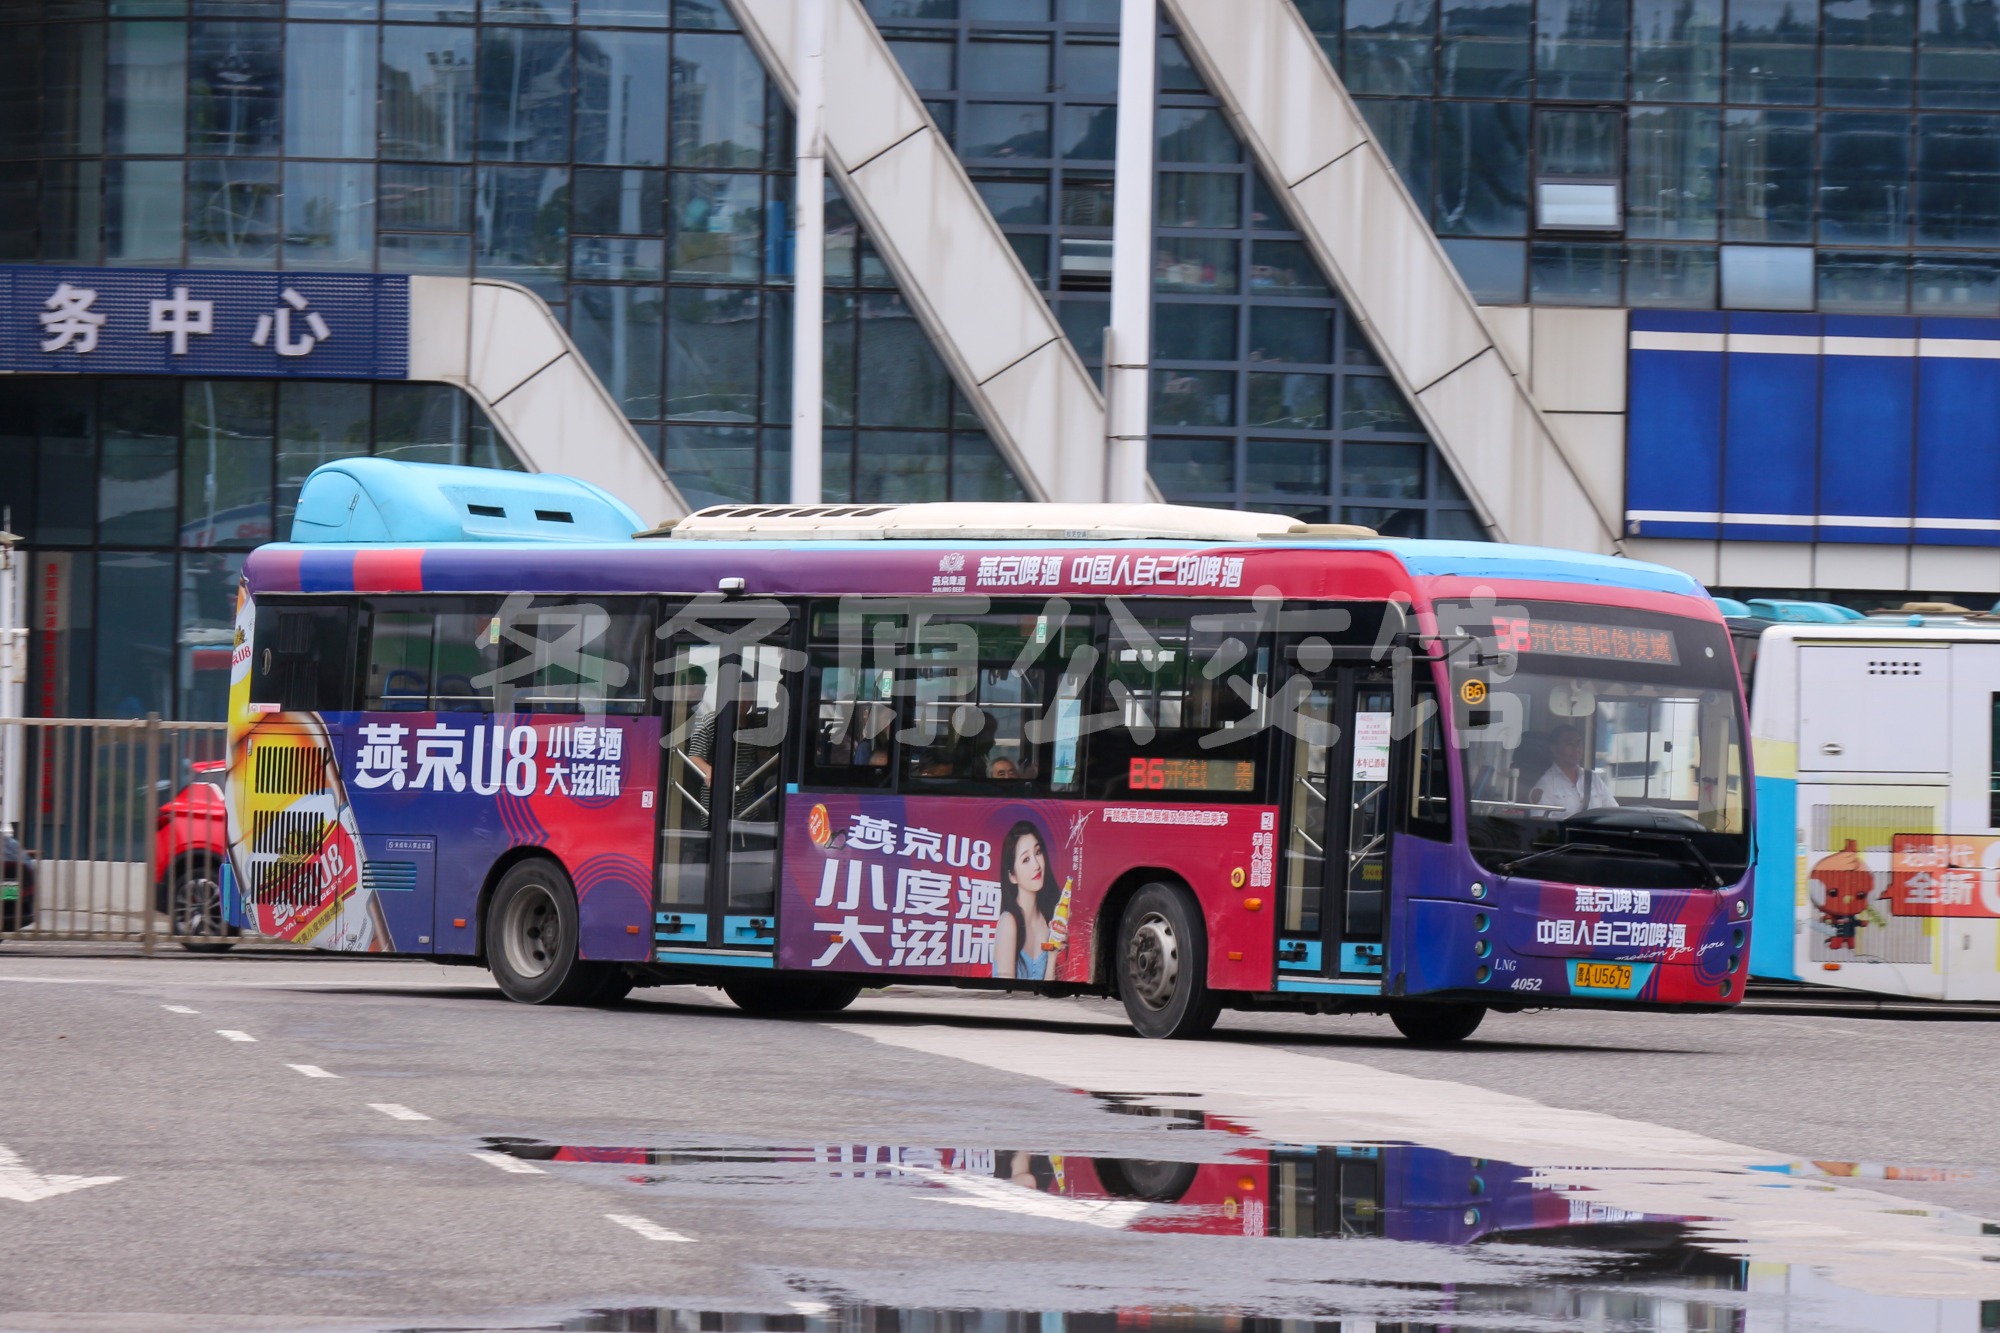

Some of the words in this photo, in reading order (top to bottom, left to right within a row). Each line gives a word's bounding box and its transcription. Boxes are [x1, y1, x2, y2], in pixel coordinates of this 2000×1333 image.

[40, 283, 331, 356] 务中心
[932, 576, 967, 586] 燕京啤酒
[976, 556, 1064, 586] 燕京啤酒
[1070, 555, 1245, 588] 中国人自己的啤酒
[1466, 685, 1481, 699] B6
[354, 723, 538, 796] 燕京U8
[546, 726, 623, 760] 小度酒
[545, 763, 620, 797] 大滋味
[1103, 808, 1228, 826] 严禁携带易燃易爆及危险物品乘车
[846, 814, 992, 871] 燕京U8
[1250, 832, 1263, 887] 无人售票
[1261, 832, 1273, 887] 自觉投币
[815, 858, 1001, 921] 小度酒
[1575, 888, 1650, 914] 燕京啤酒
[1904, 871, 1975, 905] 全新
[811, 915, 998, 967] 大滋味
[1537, 920, 1686, 948] 中国人自己的啤酒
[1696, 940, 1724, 956] you
[1494, 958, 1517, 972] LNG
[1511, 978, 1543, 991] 4052
